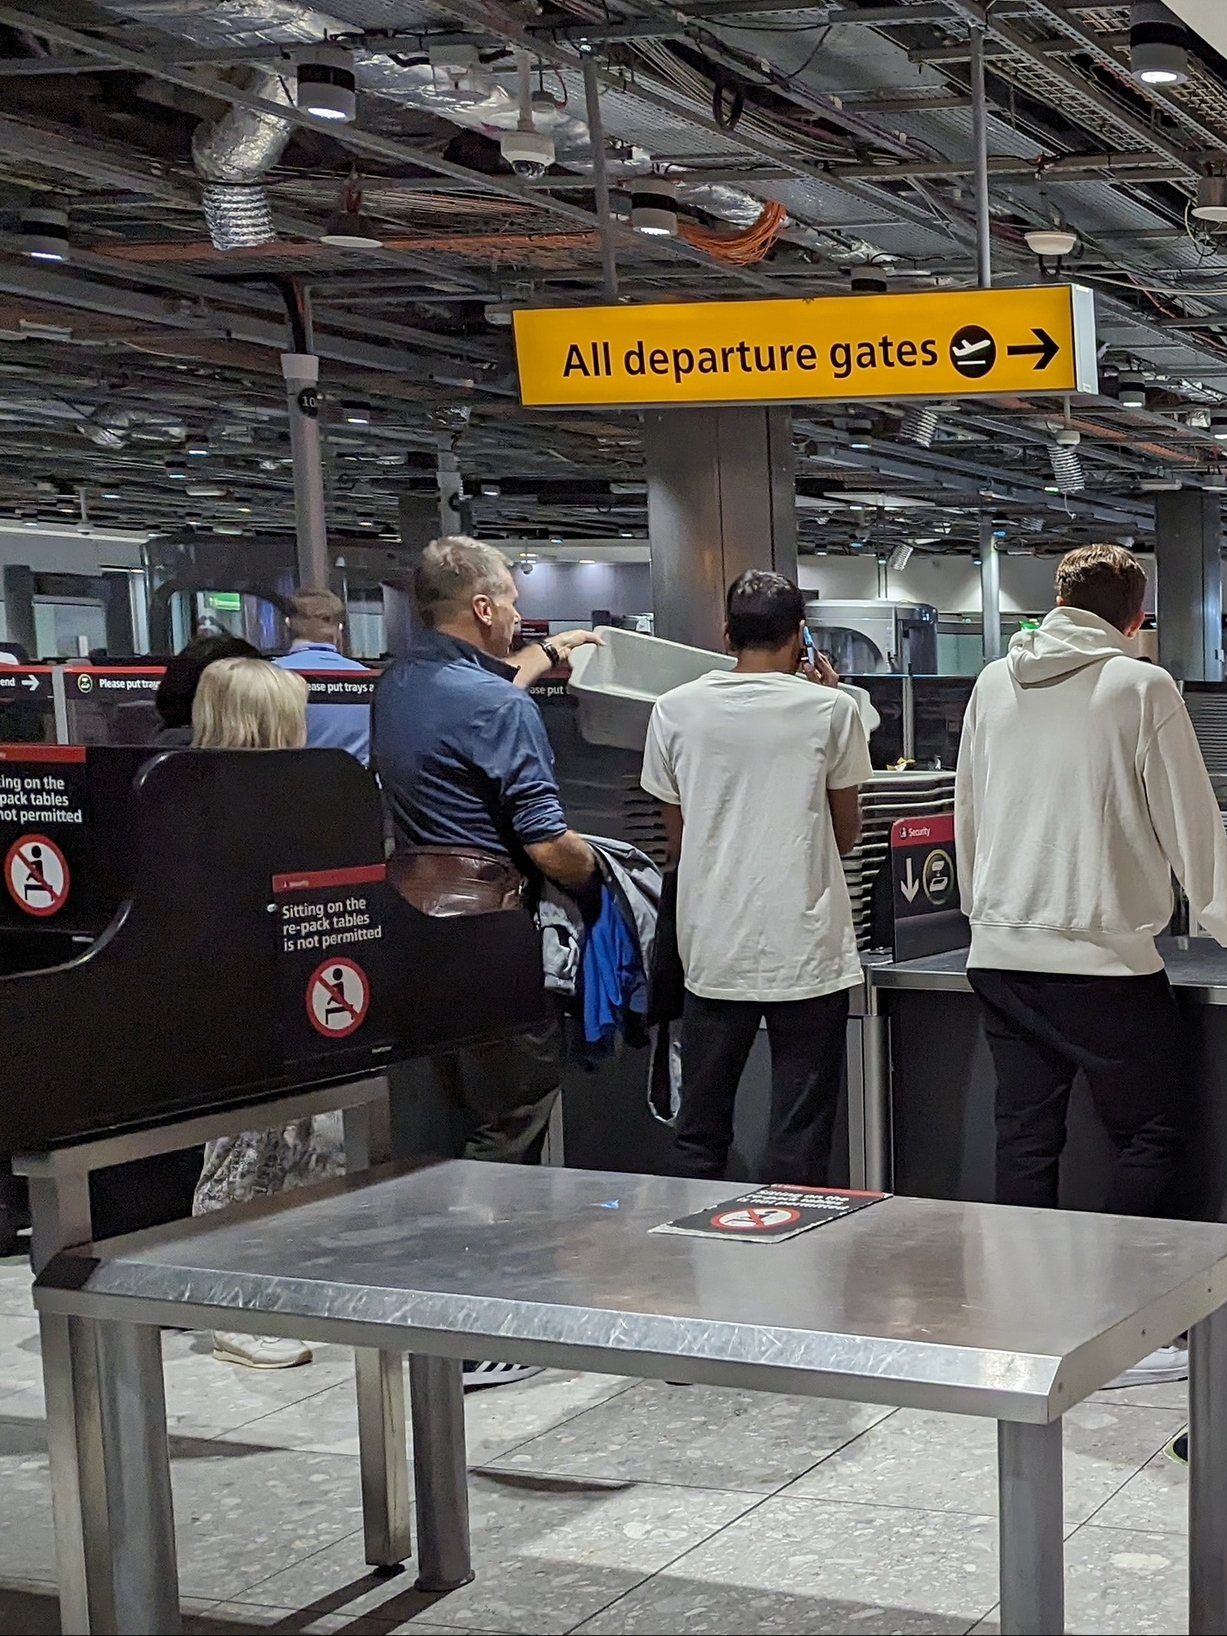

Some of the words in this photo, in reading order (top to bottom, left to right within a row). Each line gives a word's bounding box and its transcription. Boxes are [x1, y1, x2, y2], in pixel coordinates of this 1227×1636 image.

[563, 342, 611, 377] All
[624, 340, 817, 383] departure
[830, 335, 938, 379] gates
[302, 395, 316, 407] 10
[99, 678, 126, 689] Please
[127, 679, 142, 691] put
[143, 679, 161, 691] tray
[306, 683, 326, 692] ease
[327, 682, 344, 694] put
[344, 682, 368, 695] trays
[529, 686, 546, 695] ase
[547, 685, 564, 697] put
[24, 778, 41, 789] on
[43, 775, 65, 790] the
[0, 791, 28, 807] pack
[30, 791, 69, 806] tables
[20, 808, 82, 825] permitted
[908, 826, 930, 837] Security
[282, 902, 324, 919] Sitting
[327, 901, 343, 913] on
[346, 897, 366, 911] the
[283, 917, 330, 936] re-pack
[333, 913, 370, 928] tables
[284, 938, 294, 952] is
[297, 935, 319, 950] not
[322, 925, 382, 949] permitted
